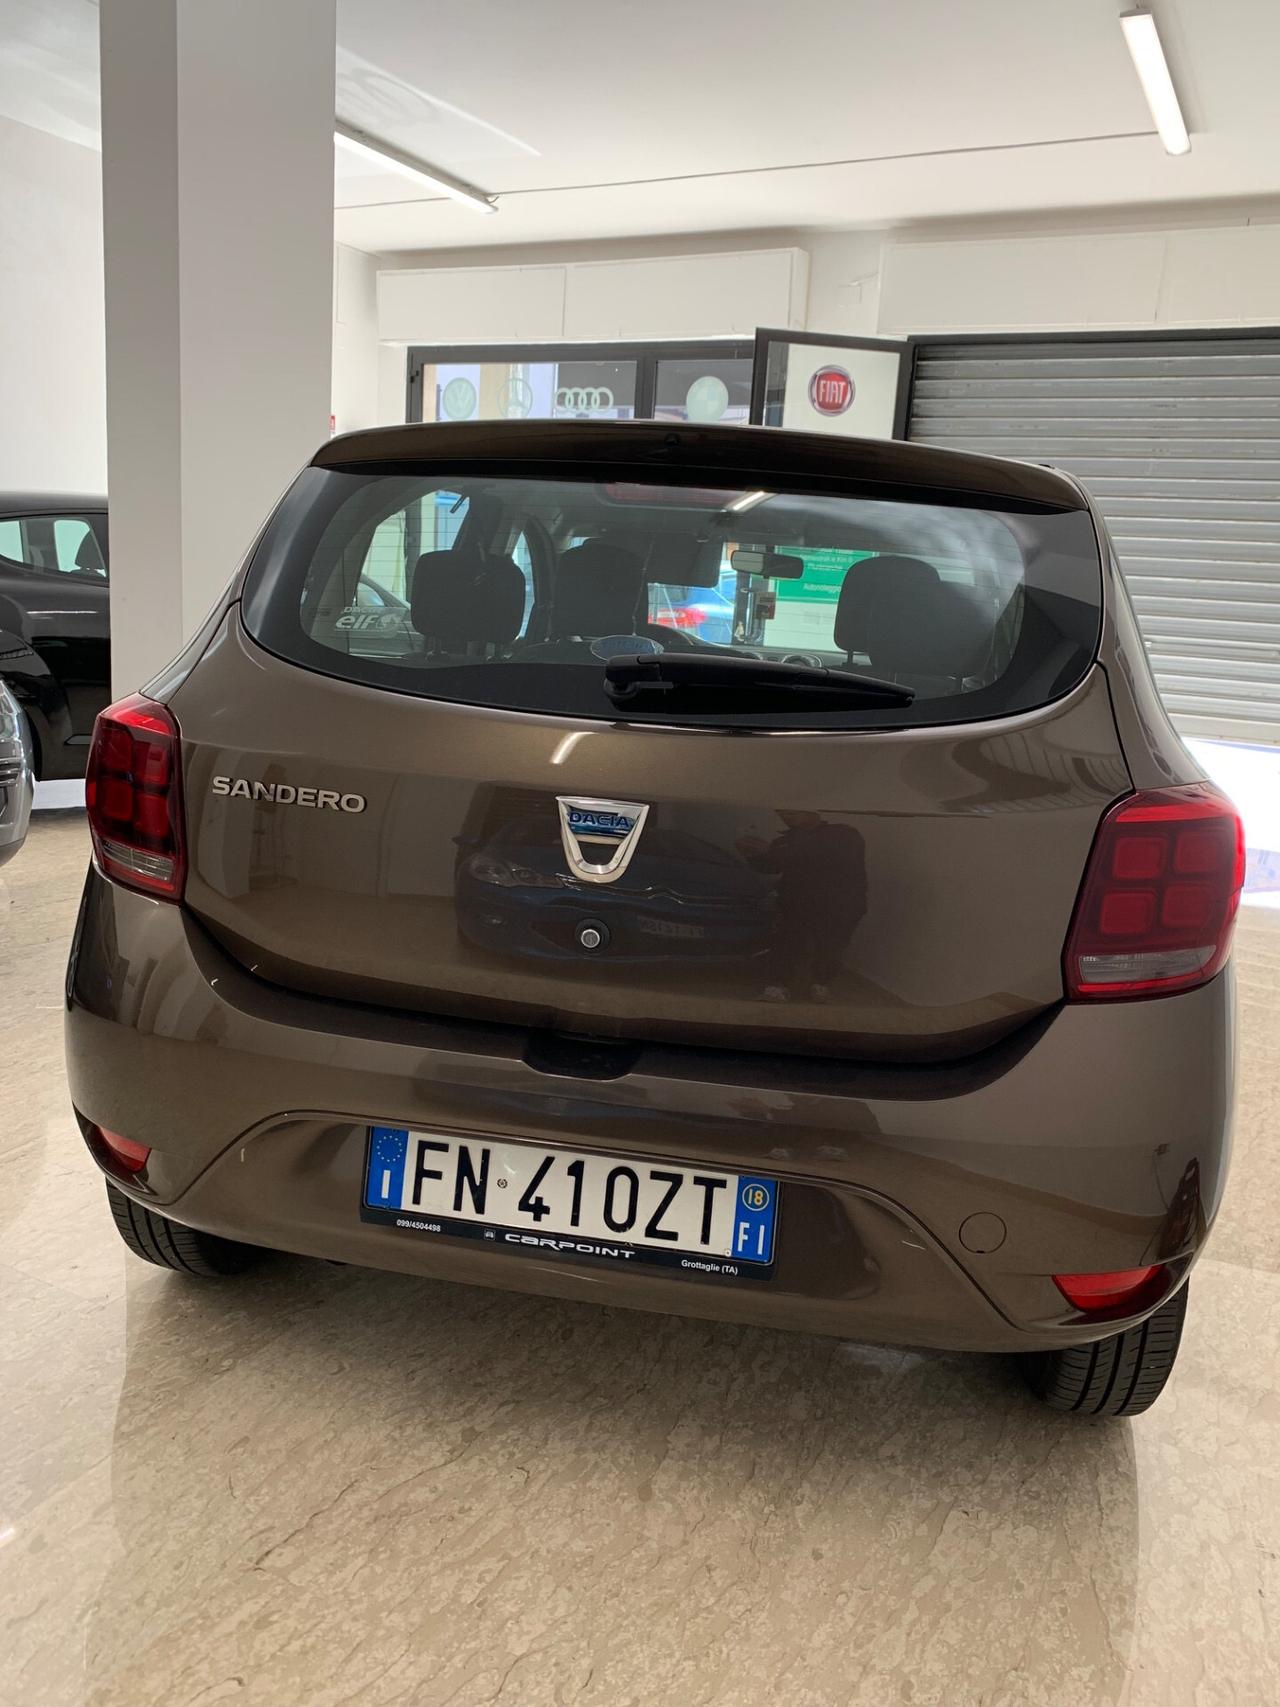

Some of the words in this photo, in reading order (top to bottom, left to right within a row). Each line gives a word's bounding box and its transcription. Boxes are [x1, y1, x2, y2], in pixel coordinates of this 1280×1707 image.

[819, 380, 846, 404] FIAT
[212, 775, 367, 813] SANDERO
[569, 812, 630, 828] DACIA
[381, 1169, 391, 1199] I
[747, 1188, 764, 1206] 18
[738, 1221, 765, 1255] FI
[681, 1259, 720, 1272] Grottaglie
[721, 1264, 738, 1275] (TA)
